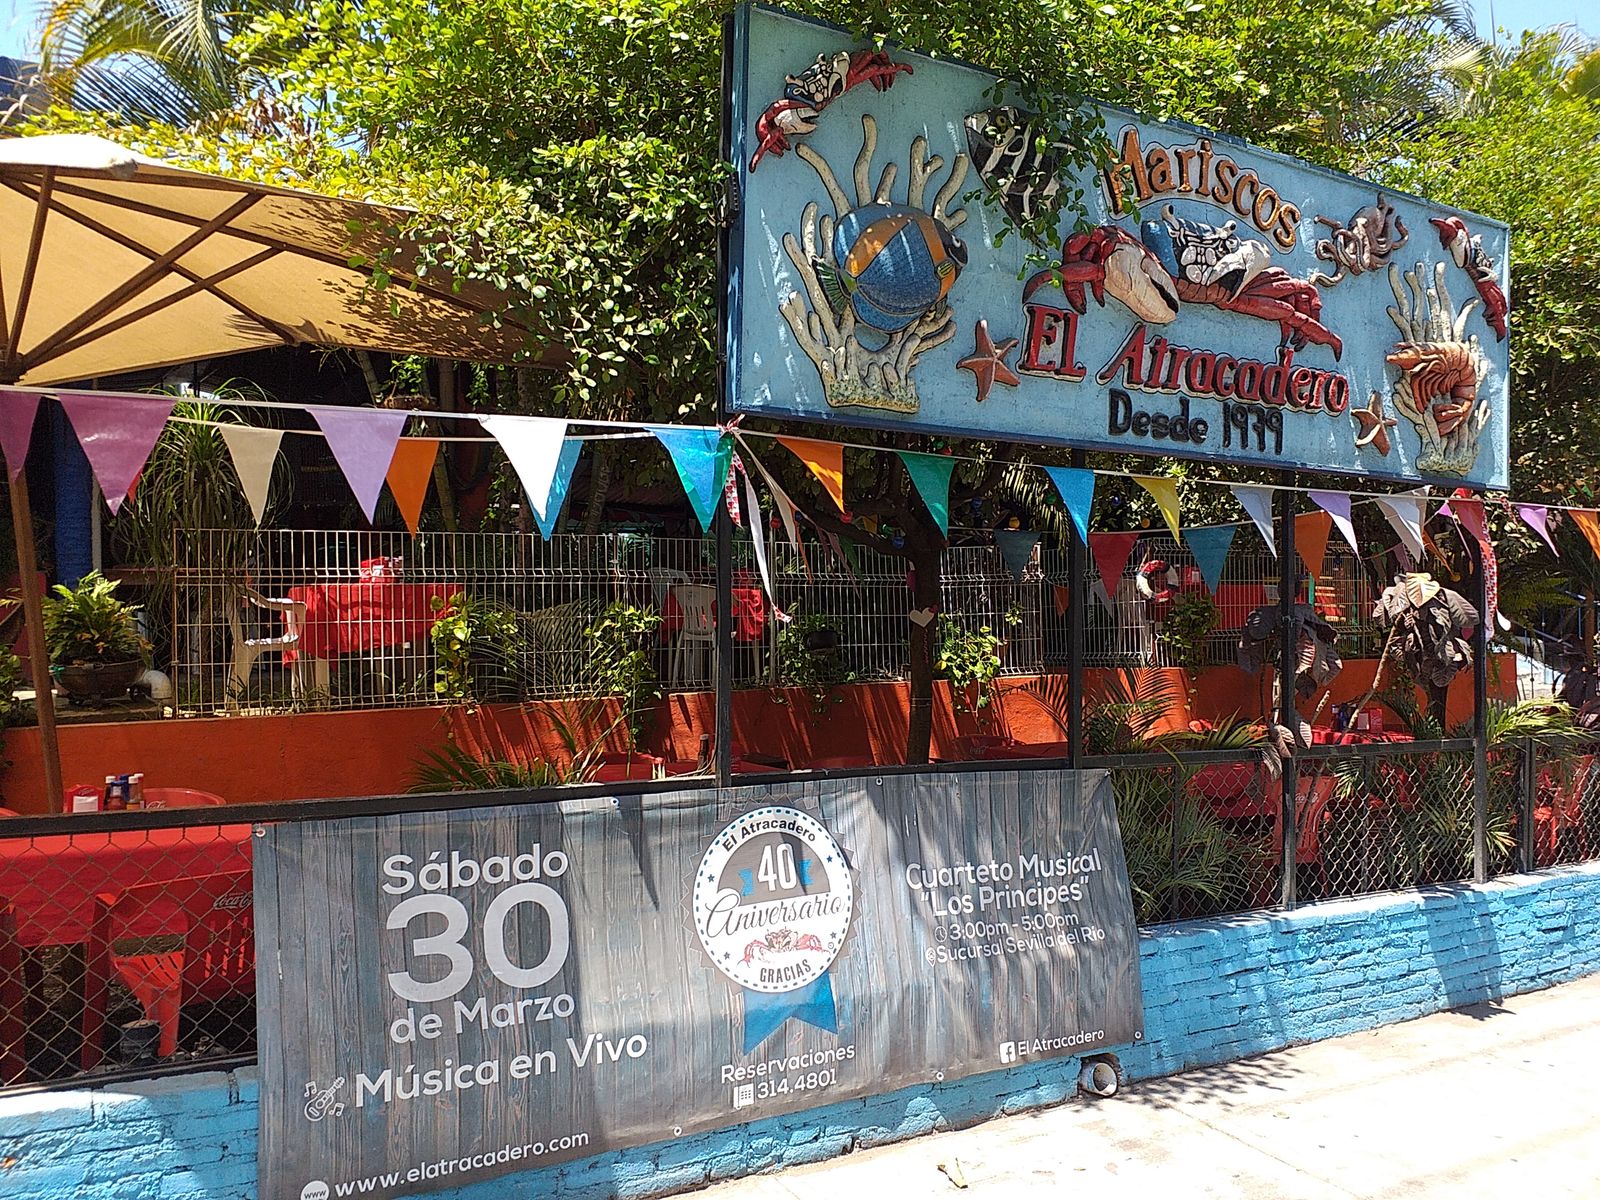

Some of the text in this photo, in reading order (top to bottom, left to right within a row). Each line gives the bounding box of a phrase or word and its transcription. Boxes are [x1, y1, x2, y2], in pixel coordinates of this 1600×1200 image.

[1104, 127, 1300, 249] Mariscos
[1019, 305, 1350, 414] El Atracadero
[1108, 389, 1284, 455] Desde 1979
[722, 818, 816, 852] El Atracadero
[382, 843, 569, 895] Sábado
[757, 842, 798, 892] 40
[905, 848, 1102, 890] Cuarteto Musical
[705, 888, 845, 938] Aniversario
[949, 919, 1010, 941] 3:00pm
[1021, 912, 1079, 932] 5:00pm
[386, 883, 570, 1002] 30
[936, 935, 1004, 963] Sucursal
[1006, 930, 1055, 955] Sevilla
[1057, 928, 1080, 948] del
[759, 958, 812, 984] GRACIAS
[391, 994, 575, 1044] de Marzo
[356, 1032, 648, 1108] Música en Vivo
[721, 1044, 856, 1084] Reservaciones
[757, 1068, 837, 1099] 314.4801
[335, 1132, 590, 1198] www.elatracadero.com
